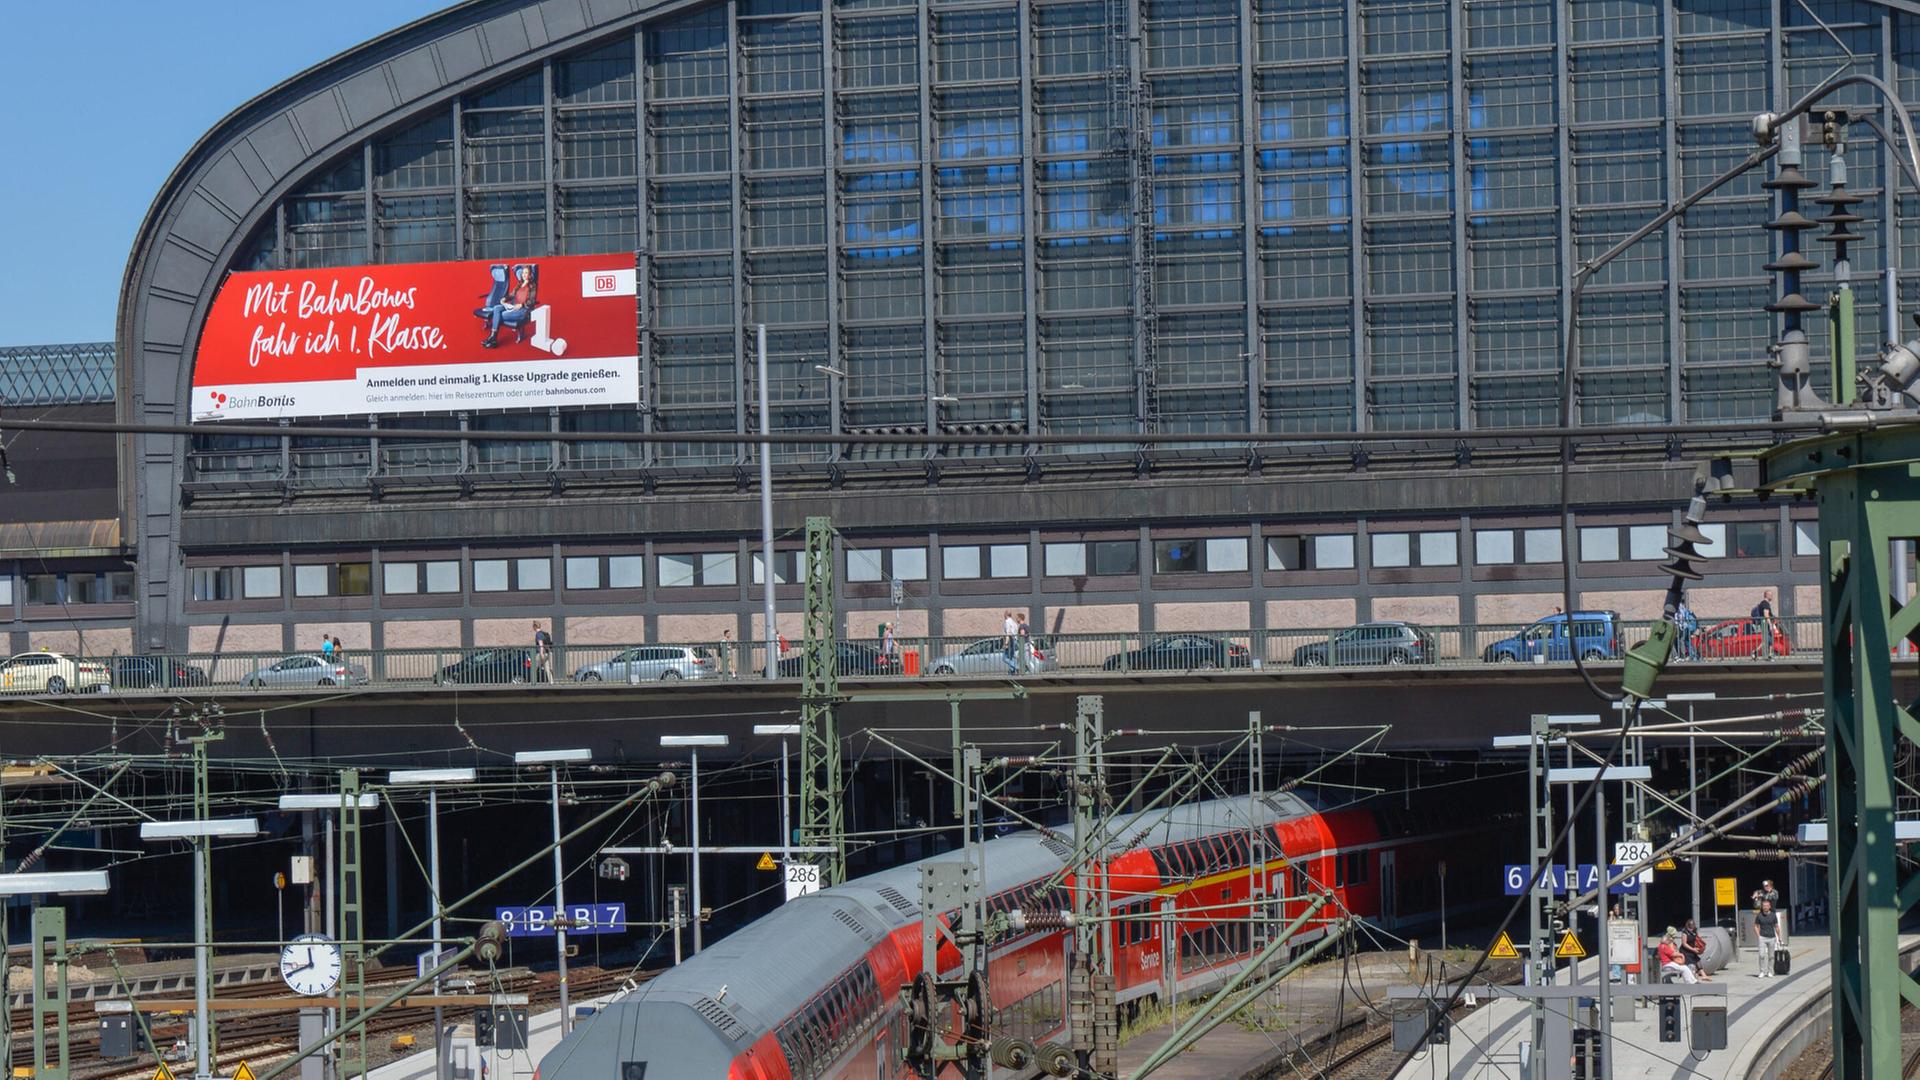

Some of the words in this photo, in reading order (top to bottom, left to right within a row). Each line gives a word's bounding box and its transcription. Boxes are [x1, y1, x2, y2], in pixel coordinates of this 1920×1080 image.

[597, 278, 613, 289] DB
[244, 281, 294, 318] Mit
[298, 276, 417, 319] BahnBonus
[249, 321, 301, 367] fahr
[304, 319, 342, 354] ich
[350, 325, 361, 354] 1.
[368, 312, 448, 359] Klasse.
[530, 304, 567, 356] 1.
[366, 377, 416, 388] Anmelden
[418, 376, 437, 386] und
[439, 373, 481, 386] einmalig
[482, 374, 491, 383] 1.
[492, 372, 525, 383] Klasse
[526, 370, 569, 383] Upgrade
[571, 368, 621, 382] genießen.
[228, 395, 296, 409] BahnBonus
[366, 393, 389, 403] Gleich
[428, 392, 443, 400] hier
[444, 391, 454, 400] im
[455, 389, 505, 399] Reisezentrum
[505, 388, 523, 398] oder
[524, 388, 544, 397] unter
[545, 386, 606, 396] bahnbonus.com
[1619, 845, 1649, 861] 286
[789, 868, 816, 882] 286
[1507, 867, 1523, 889] 6
[530, 910, 545, 931] B
[575, 908, 590, 930] B
[606, 906, 620, 928] 7
[1141, 949, 1159, 970] Service
